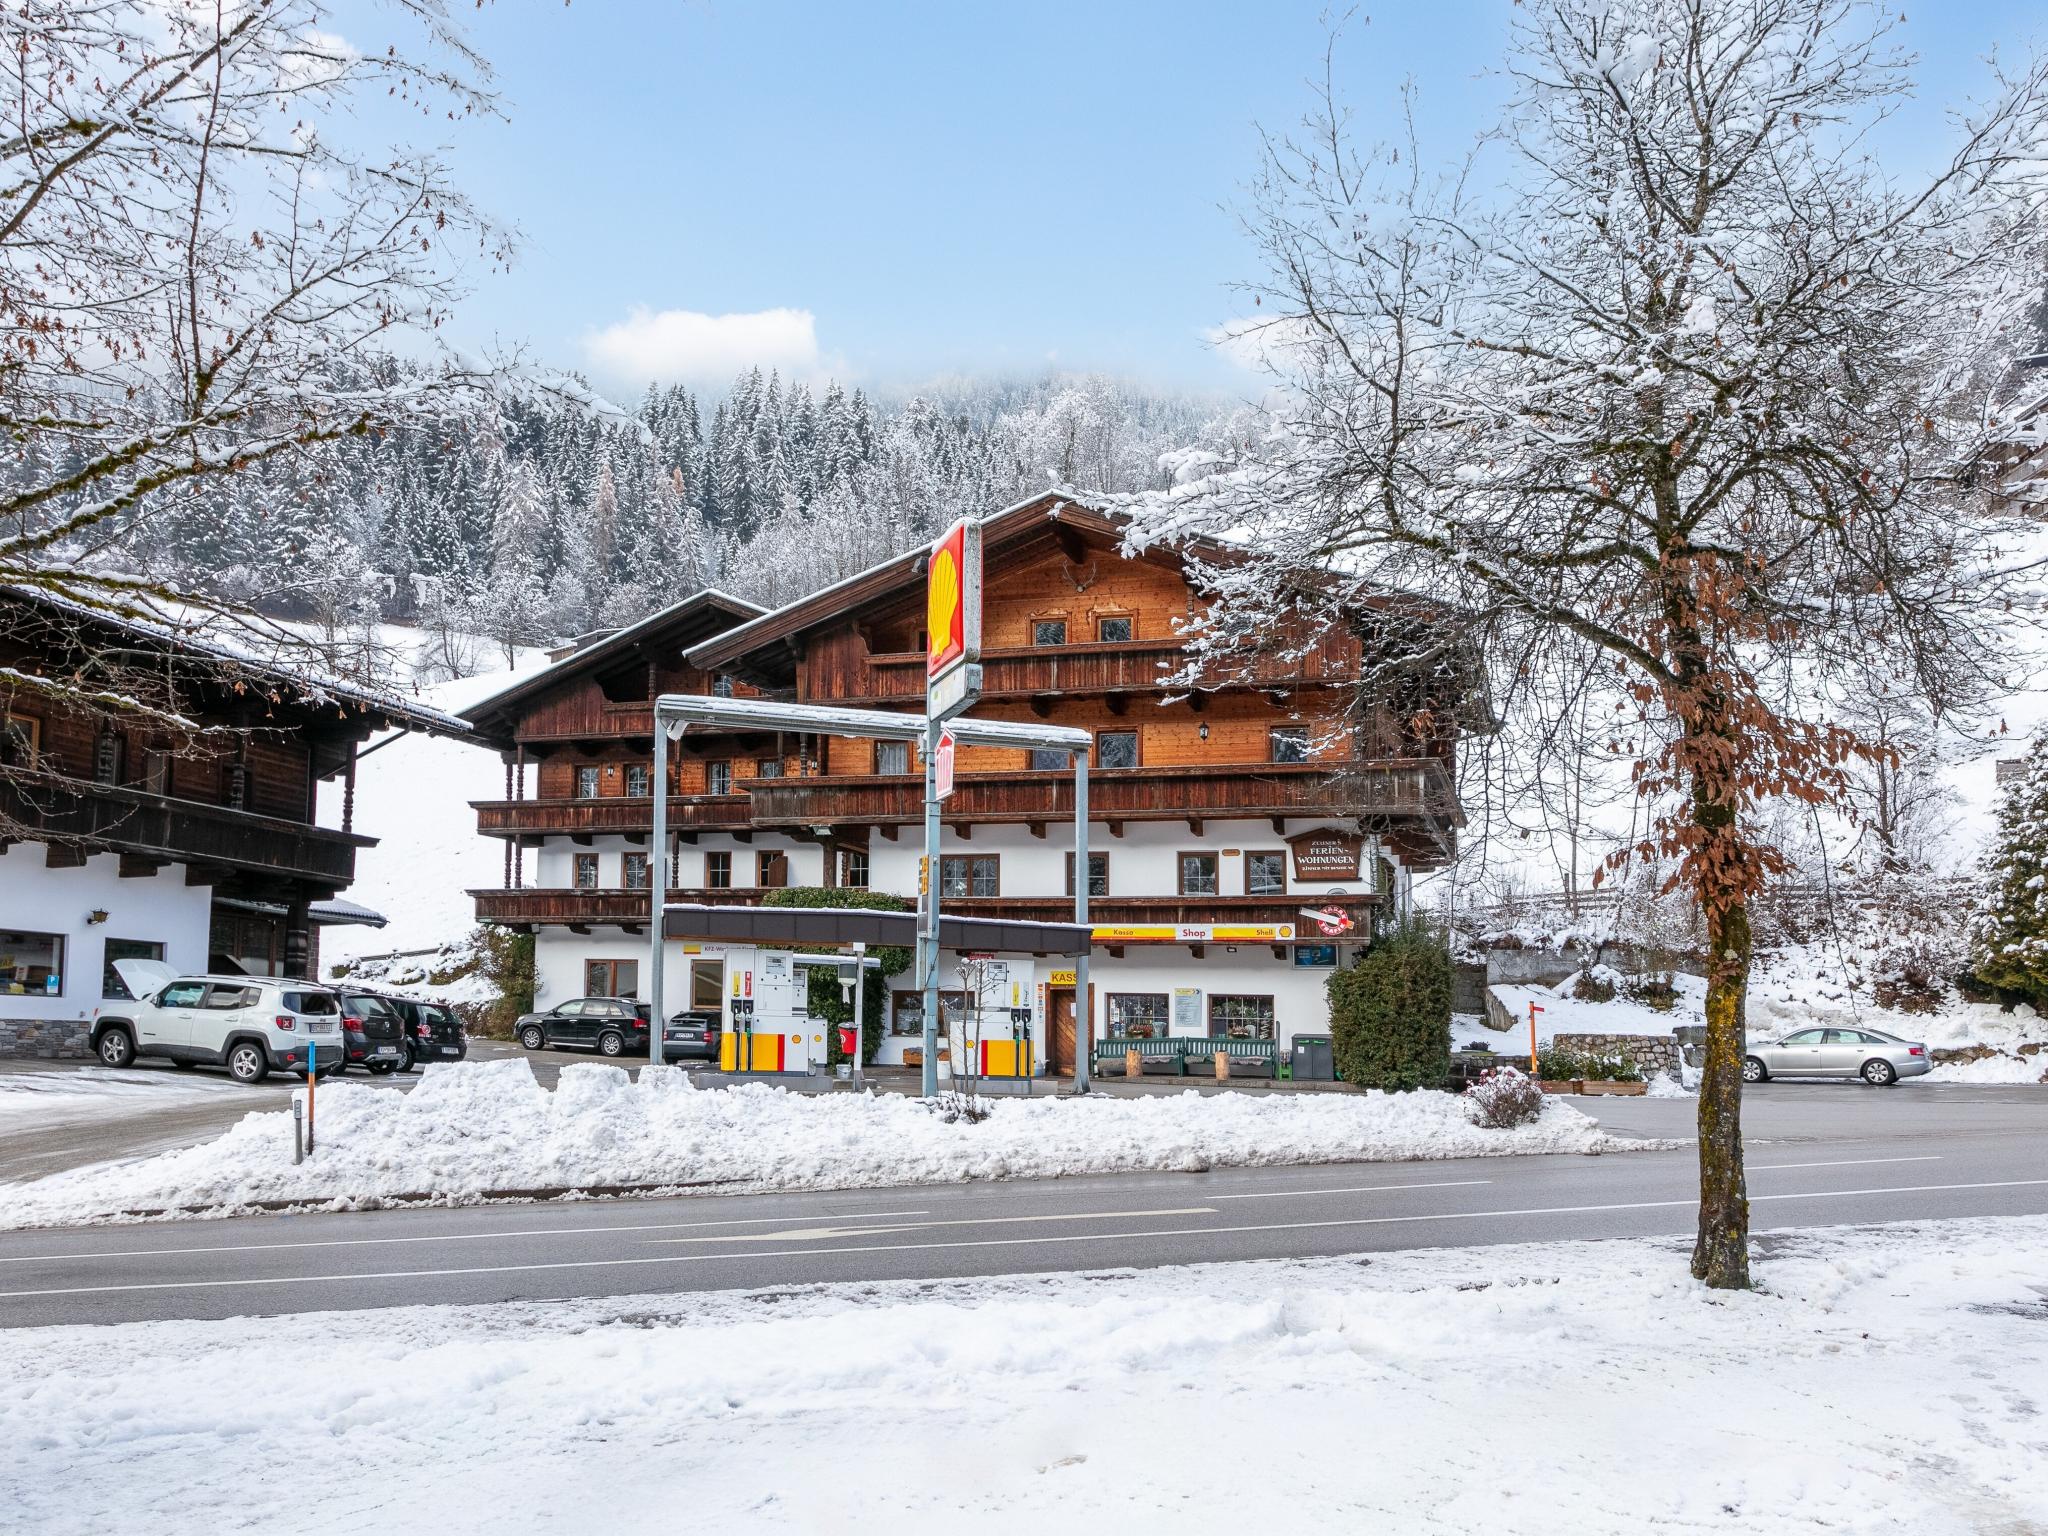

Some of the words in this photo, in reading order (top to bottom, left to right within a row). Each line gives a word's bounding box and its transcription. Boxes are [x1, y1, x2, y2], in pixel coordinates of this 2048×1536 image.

[1297, 856, 1355, 864] WOHNUNGEN
[1319, 921, 1346, 934] TRAFIK
[1182, 928, 1206, 939] Shop
[1051, 973, 1077, 982] KASS
